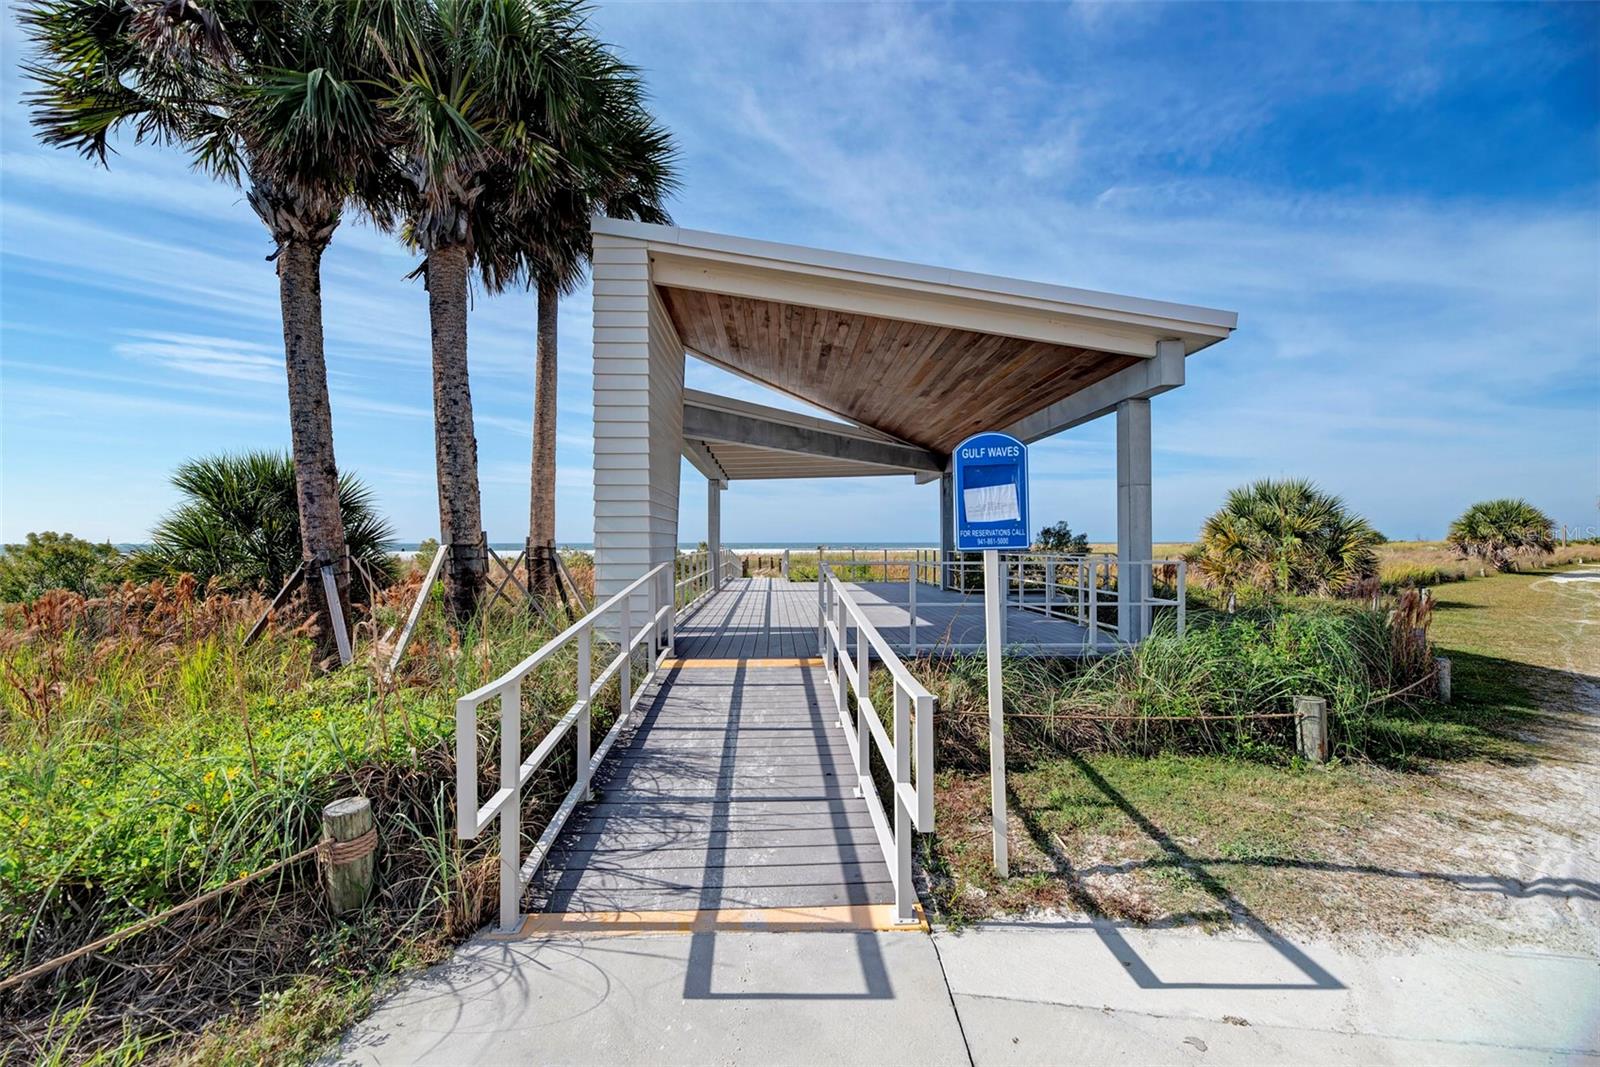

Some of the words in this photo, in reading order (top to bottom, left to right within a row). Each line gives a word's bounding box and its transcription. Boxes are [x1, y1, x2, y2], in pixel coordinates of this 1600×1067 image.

[961, 448, 986, 459] GULF
[988, 446, 1020, 457] WAVES
[972, 529, 1011, 537] RESERVATIONS
[1012, 528, 1025, 536] CALL
